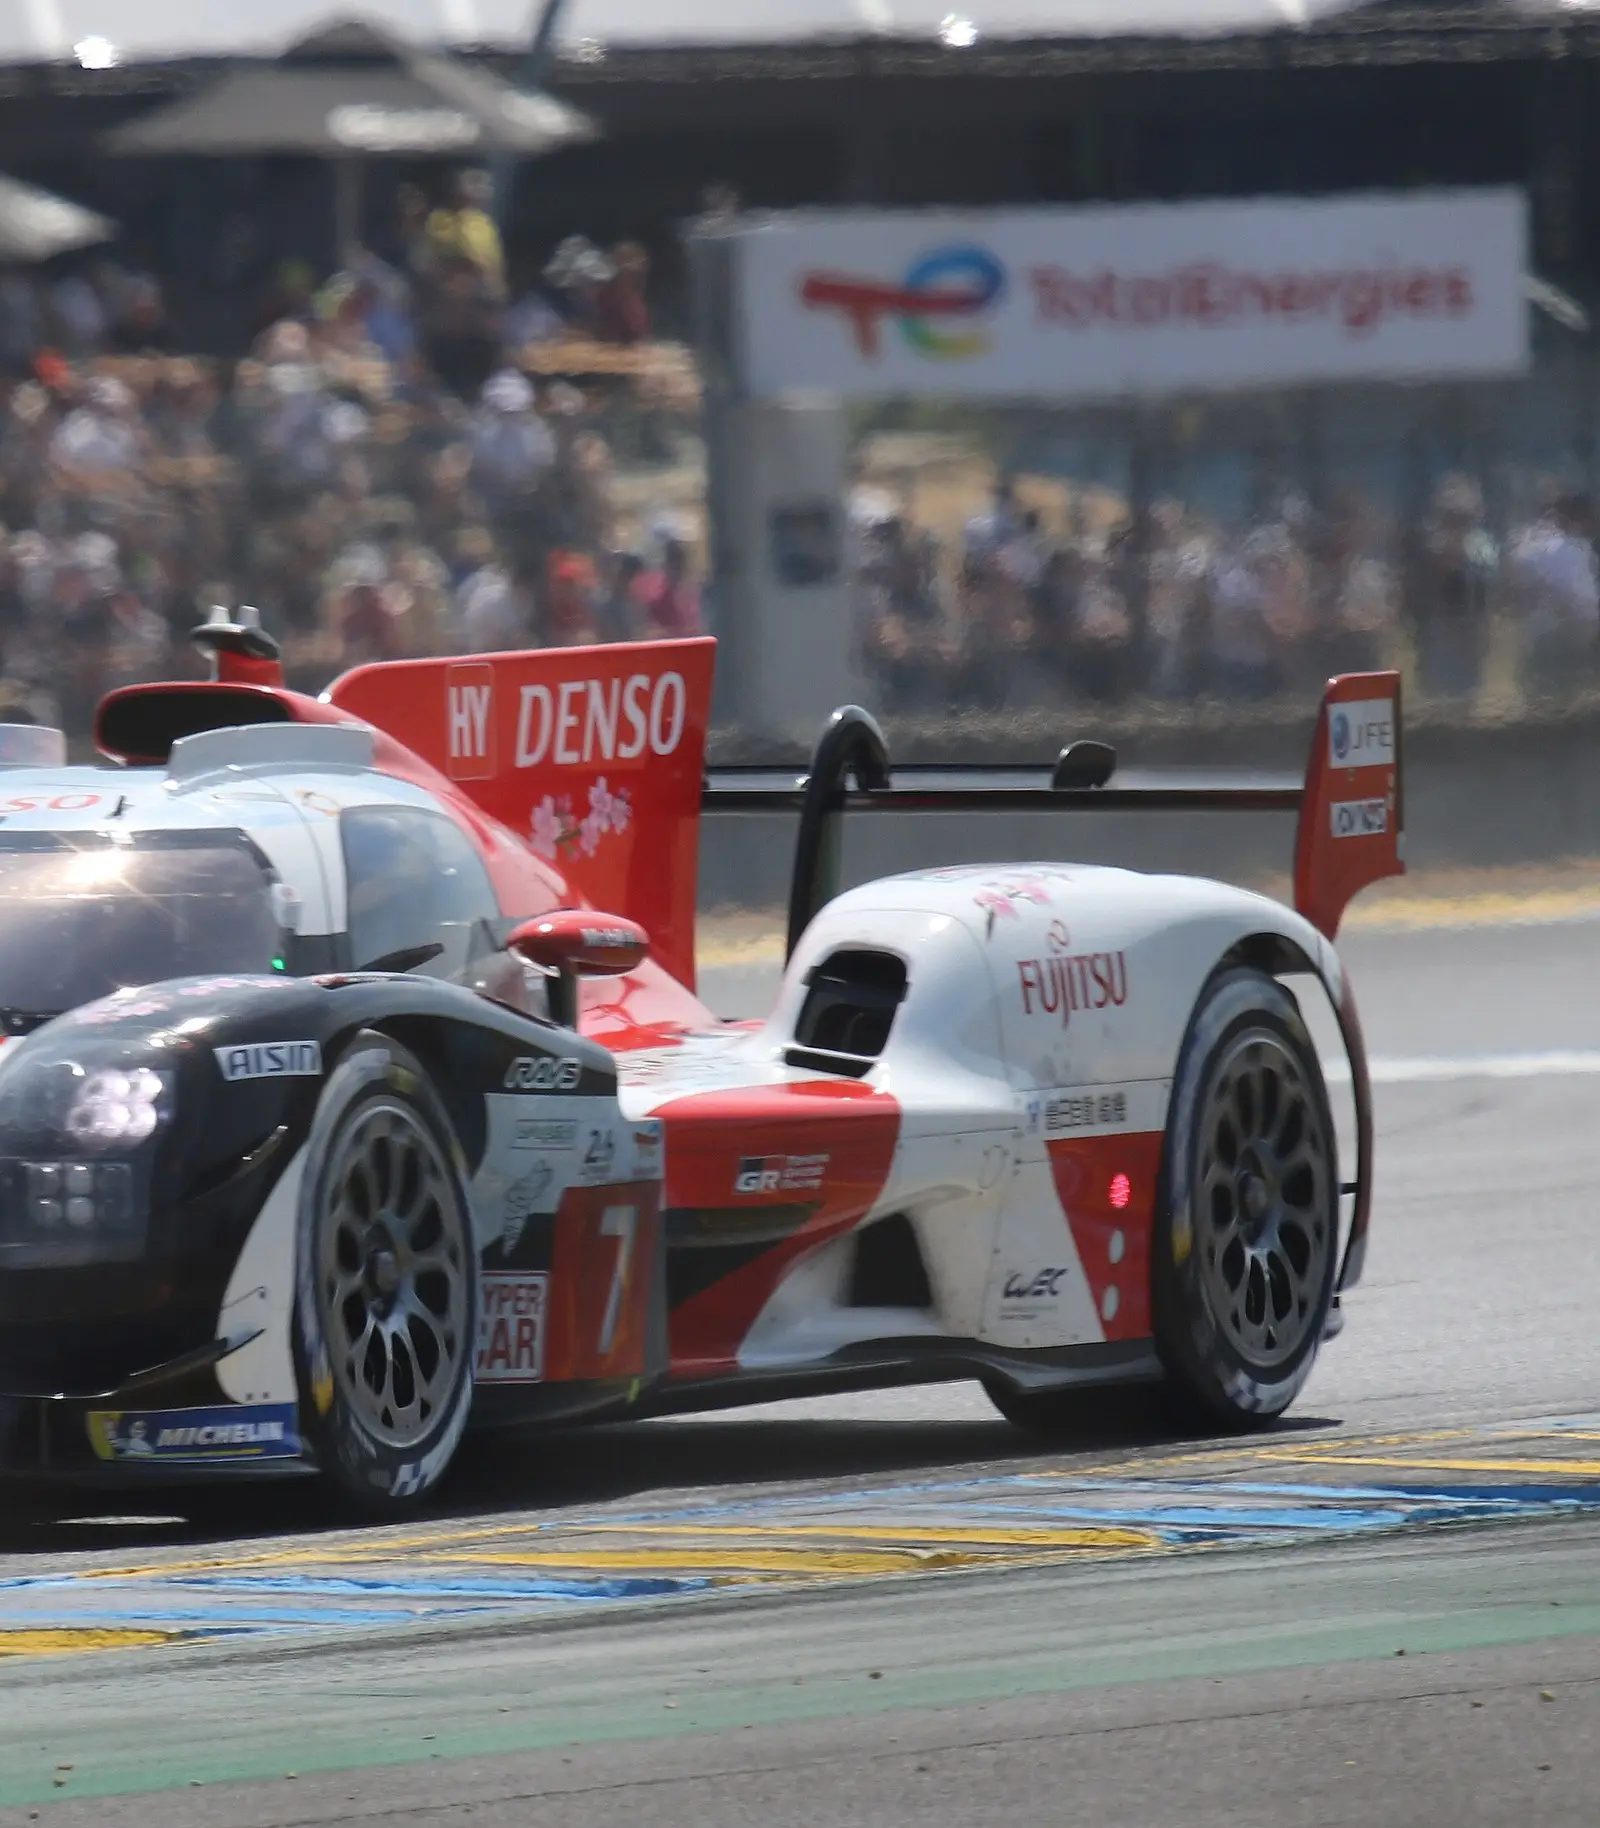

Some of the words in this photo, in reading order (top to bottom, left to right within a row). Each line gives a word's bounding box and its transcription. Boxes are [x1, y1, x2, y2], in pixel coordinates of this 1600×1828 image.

[1028, 262, 1474, 342] TotalEnergies
[449, 684, 491, 758] HY
[514, 669, 687, 769] DENSO
[1353, 721, 1393, 750] JFE
[1016, 950, 1127, 1031] FUJITSU
[228, 1044, 317, 1078] AISIN
[735, 1170, 781, 1192] GR
[482, 1283, 544, 1316] YPER
[598, 1204, 638, 1356] 7
[156, 1421, 285, 1448] MICHELIN
